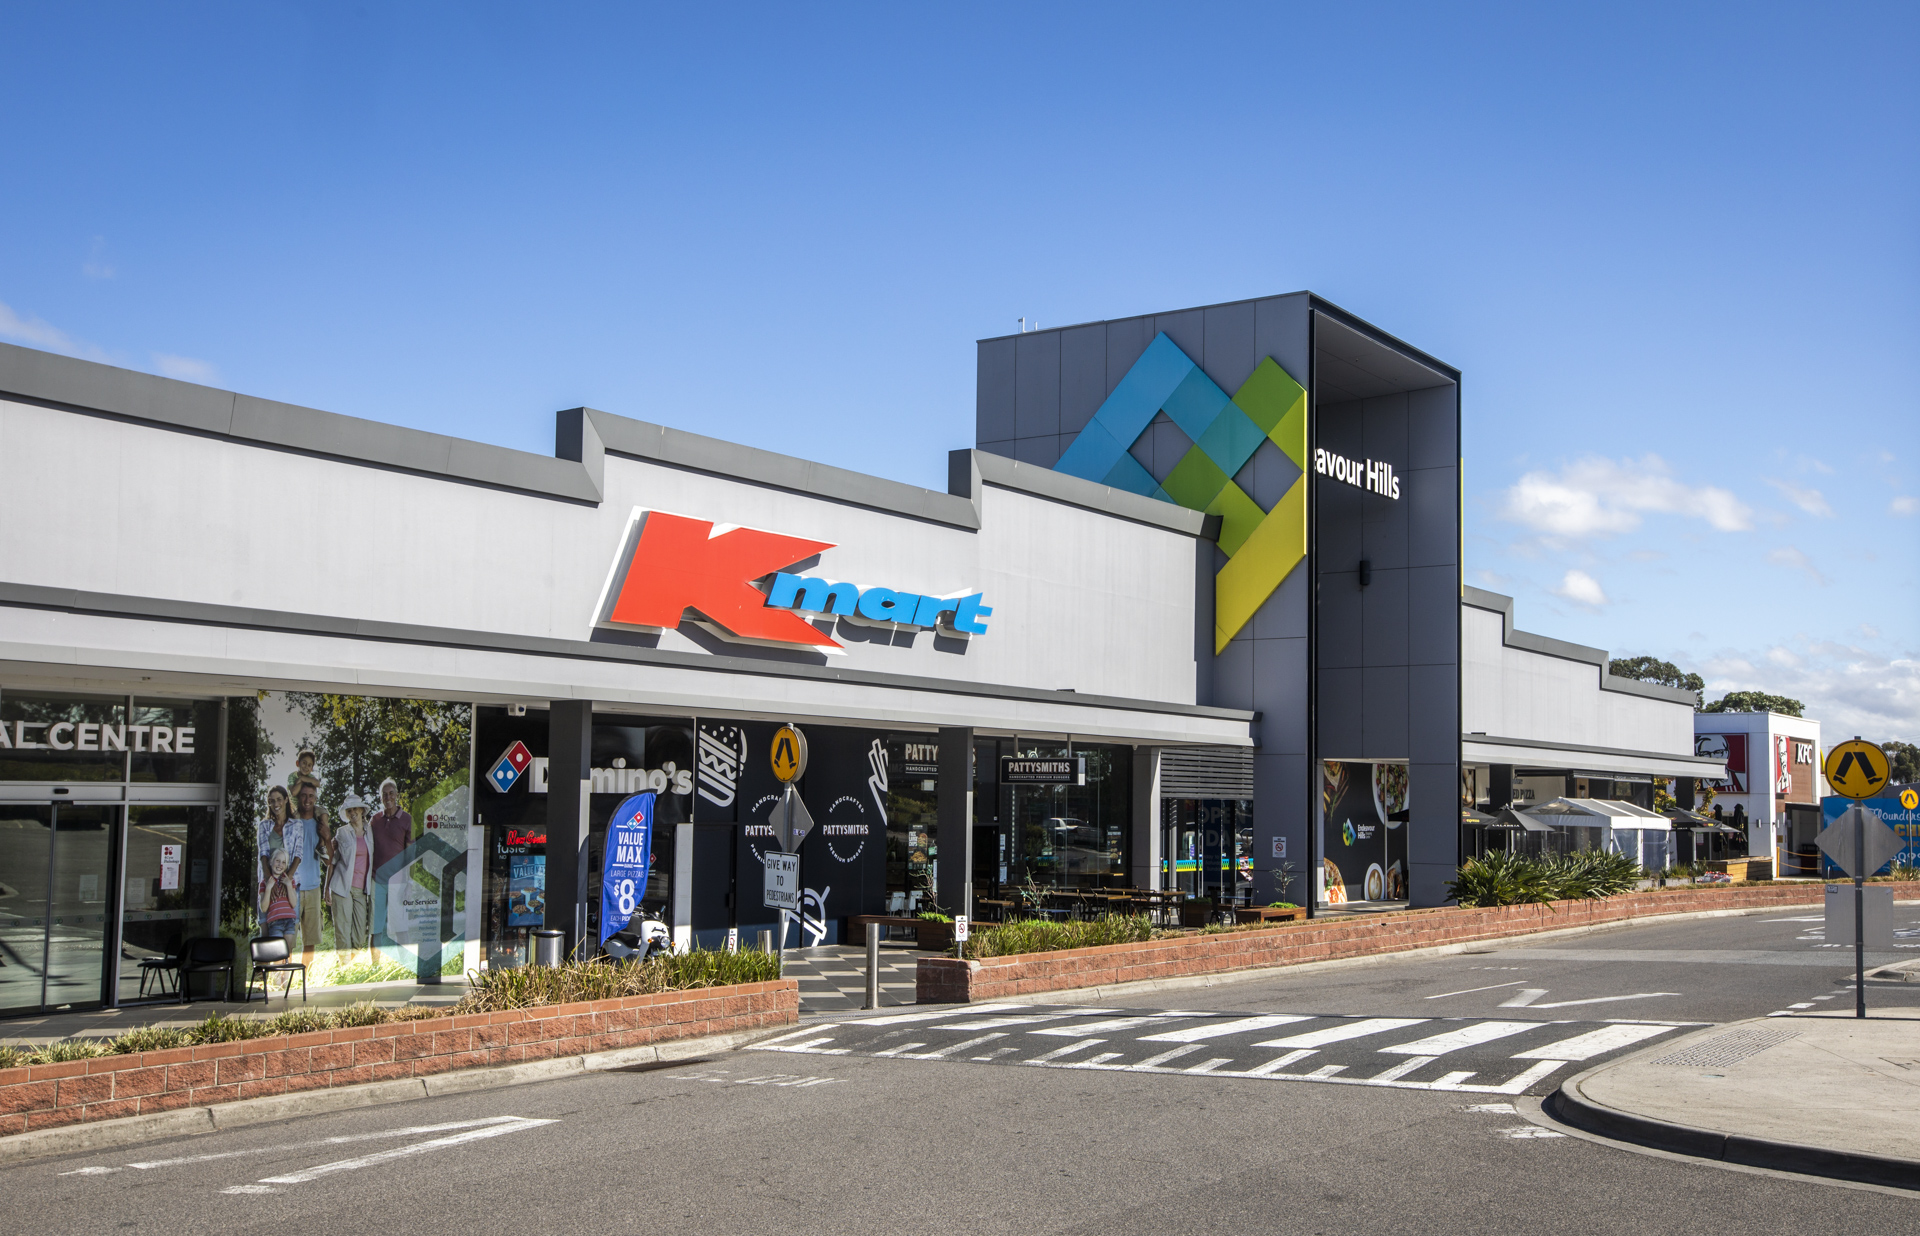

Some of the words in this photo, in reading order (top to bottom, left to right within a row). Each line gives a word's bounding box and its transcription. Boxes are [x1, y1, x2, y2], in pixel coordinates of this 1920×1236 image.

[1366, 458, 1400, 500] Hills
[608, 510, 994, 650] Kmart
[49, 722, 196, 754] CENTRE
[1797, 742, 1813, 764] KFC
[1008, 761, 1071, 774] PATTYSMITHS
[529, 756, 693, 796] Dmino's
[1520, 789, 1536, 800] PIZZA
[829, 795, 864, 813] HANDCRAFTED
[440, 822, 467, 831] Pathology
[745, 824, 776, 837] PATTYS
[822, 824, 869, 836] PATTYSMITHS
[618, 832, 644, 846] VALUE
[616, 846, 643, 863] MAX
[767, 858, 780, 870] GIVE
[782, 860, 796, 872] WAY
[776, 875, 784, 886] TO
[415, 898, 438, 906] Services
[766, 889, 795, 904] PEDESTRIANS
